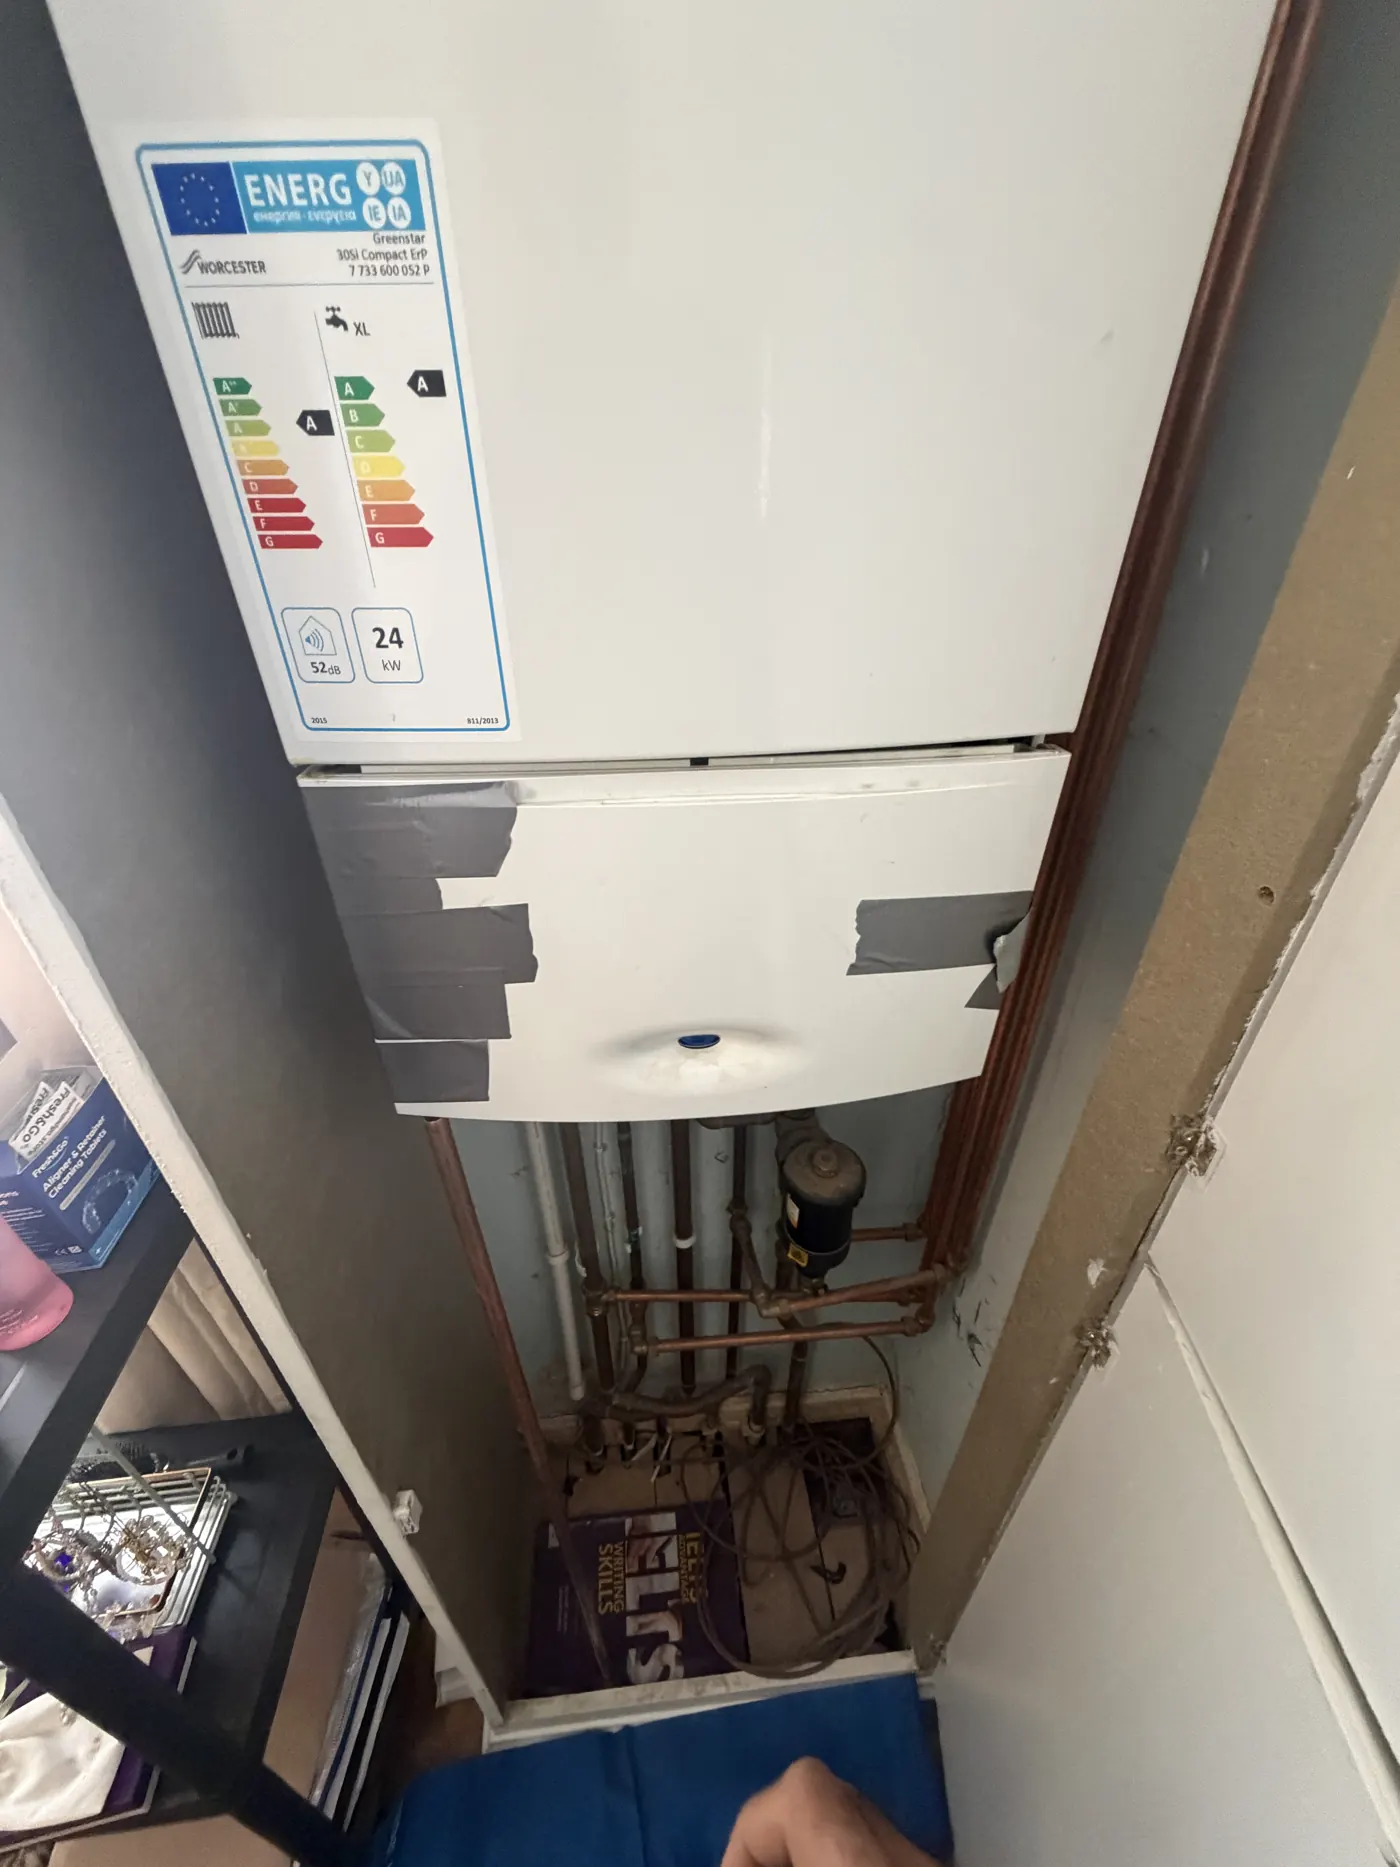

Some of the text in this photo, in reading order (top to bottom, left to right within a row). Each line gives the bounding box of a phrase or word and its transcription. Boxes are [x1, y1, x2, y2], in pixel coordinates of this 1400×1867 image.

[244, 173, 352, 206] ENERG
[368, 205, 407, 221] IE IA
[373, 232, 425, 245] Greenstar
[337, 248, 428, 263] 30Si Compact ErP
[197, 260, 266, 274] WORCESTER
[349, 264, 430, 276] 7 733 600 052 P
[353, 321, 371, 336] XL
[344, 382, 355, 397] A
[417, 376, 429, 392] A
[306, 415, 318, 431] A
[349, 409, 359, 423] B
[234, 422, 243, 434] A
[354, 435, 365, 449] C
[244, 462, 253, 473] C
[361, 460, 371, 474] D
[249, 481, 259, 492] D
[365, 484, 374, 498] E
[254, 499, 263, 511] E
[370, 508, 377, 521] F
[260, 518, 267, 529] F
[265, 536, 274, 547] G
[375, 532, 385, 544] G
[372, 627, 404, 649] 24
[382, 659, 401, 671] kW
[22, 1087, 71, 1143] Fresh&Go
[32, 1139, 69, 1178] Fresh&Go
[43, 1157, 72, 1192] Aligner
[71, 1150, 79, 1159] &
[76, 1115, 106, 1152] Retainer
[48, 1158, 84, 1198] Cleaning
[81, 1128, 107, 1159] Tablets
[598, 1543, 613, 1616] SKILLS
[613, 1541, 625, 1614] WRITING
[626, 1511, 685, 1684] IELTS
